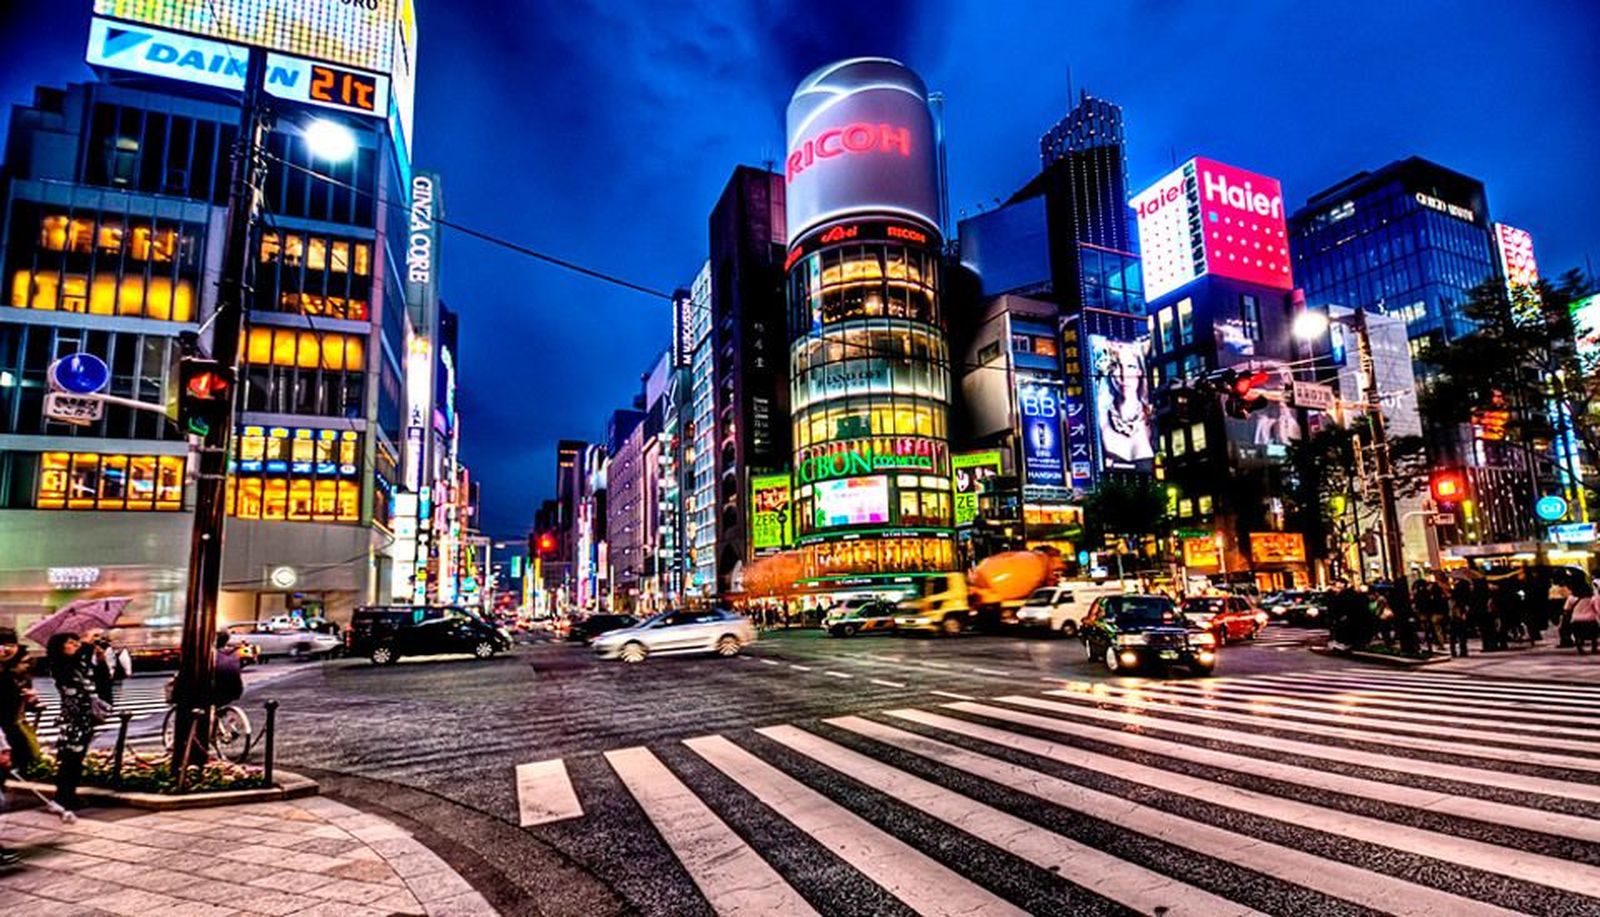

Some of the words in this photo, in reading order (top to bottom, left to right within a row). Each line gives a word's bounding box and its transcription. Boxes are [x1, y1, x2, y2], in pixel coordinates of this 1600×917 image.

[145, 43, 299, 87] DAIKN
[786, 122, 911, 184] RICOH
[410, 176, 432, 231] GINZA
[1204, 171, 1281, 219] Haier
[409, 233, 431, 283] CORE
